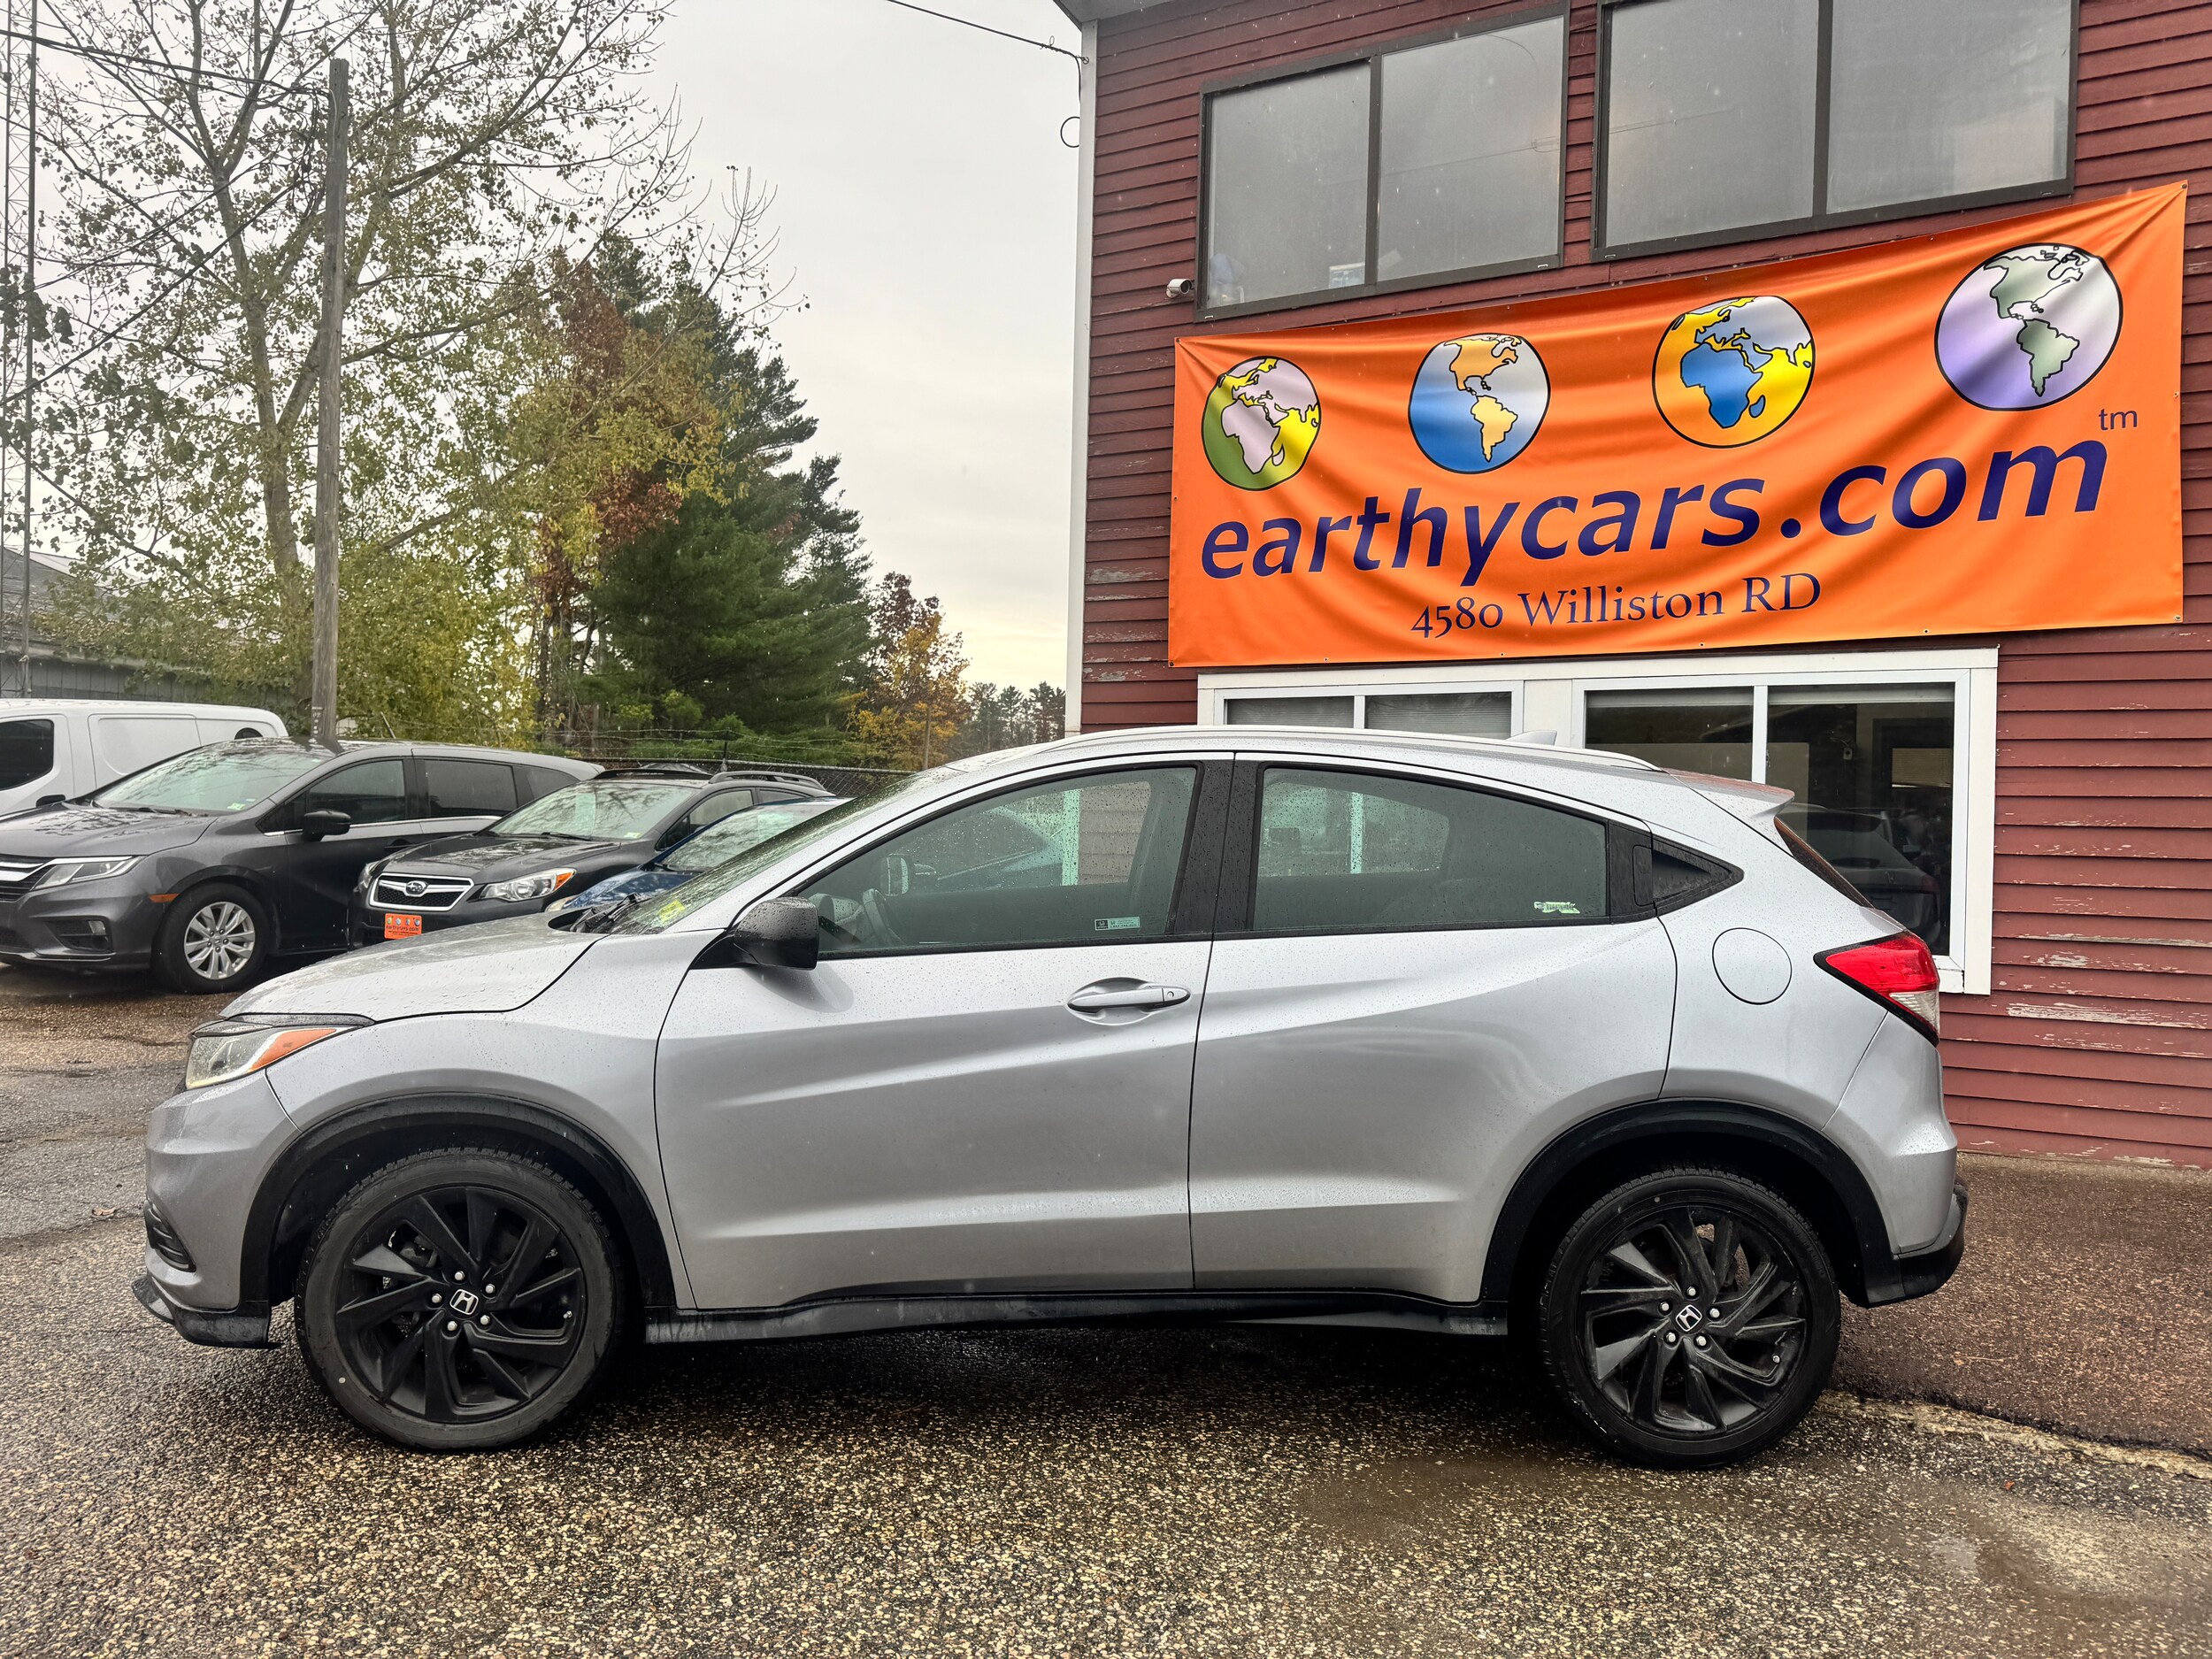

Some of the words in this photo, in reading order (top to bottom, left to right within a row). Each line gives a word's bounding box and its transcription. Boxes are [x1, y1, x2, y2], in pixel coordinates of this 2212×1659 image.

[1202, 439, 2108, 588] earthycars.com
[1411, 598, 1504, 638] 4580
[1517, 585, 1724, 626] Williston
[1742, 572, 1822, 612] RD
